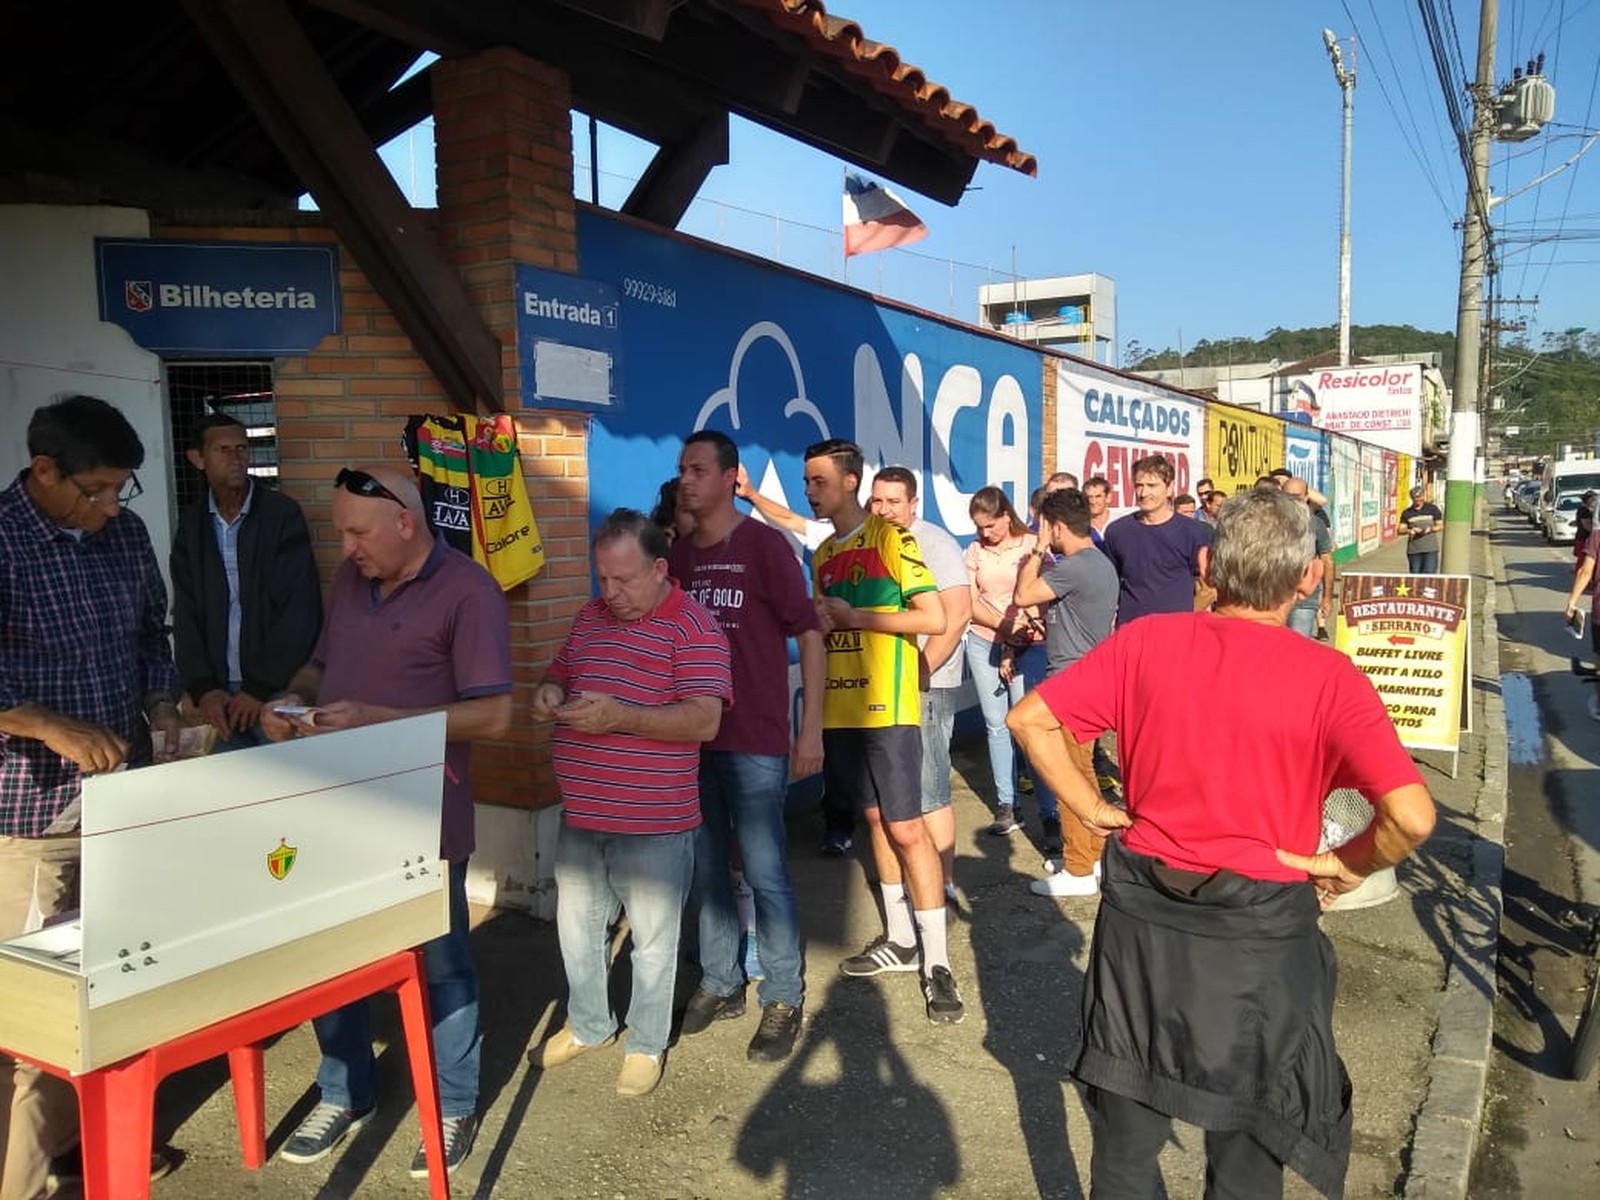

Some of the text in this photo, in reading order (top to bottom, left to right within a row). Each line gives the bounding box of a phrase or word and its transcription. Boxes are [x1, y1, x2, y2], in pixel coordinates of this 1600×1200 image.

[159, 284, 316, 309] Bilheteria
[524, 292, 614, 326] Entrada 1
[1318, 369, 1413, 390] Resicolor
[1084, 388, 1190, 437] CALÇADOS
[713, 588, 744, 608] GOLD
[1352, 602, 1456, 622] RESTAURANTE
[1371, 621, 1431, 634] SERRANO
[1357, 647, 1444, 661] BUFFET LIVRE
[1400, 668, 1409, 676] A
[1412, 669, 1443, 679] KILO
[1376, 685, 1444, 697] MARMITAS
[1403, 706, 1436, 716] PARA
